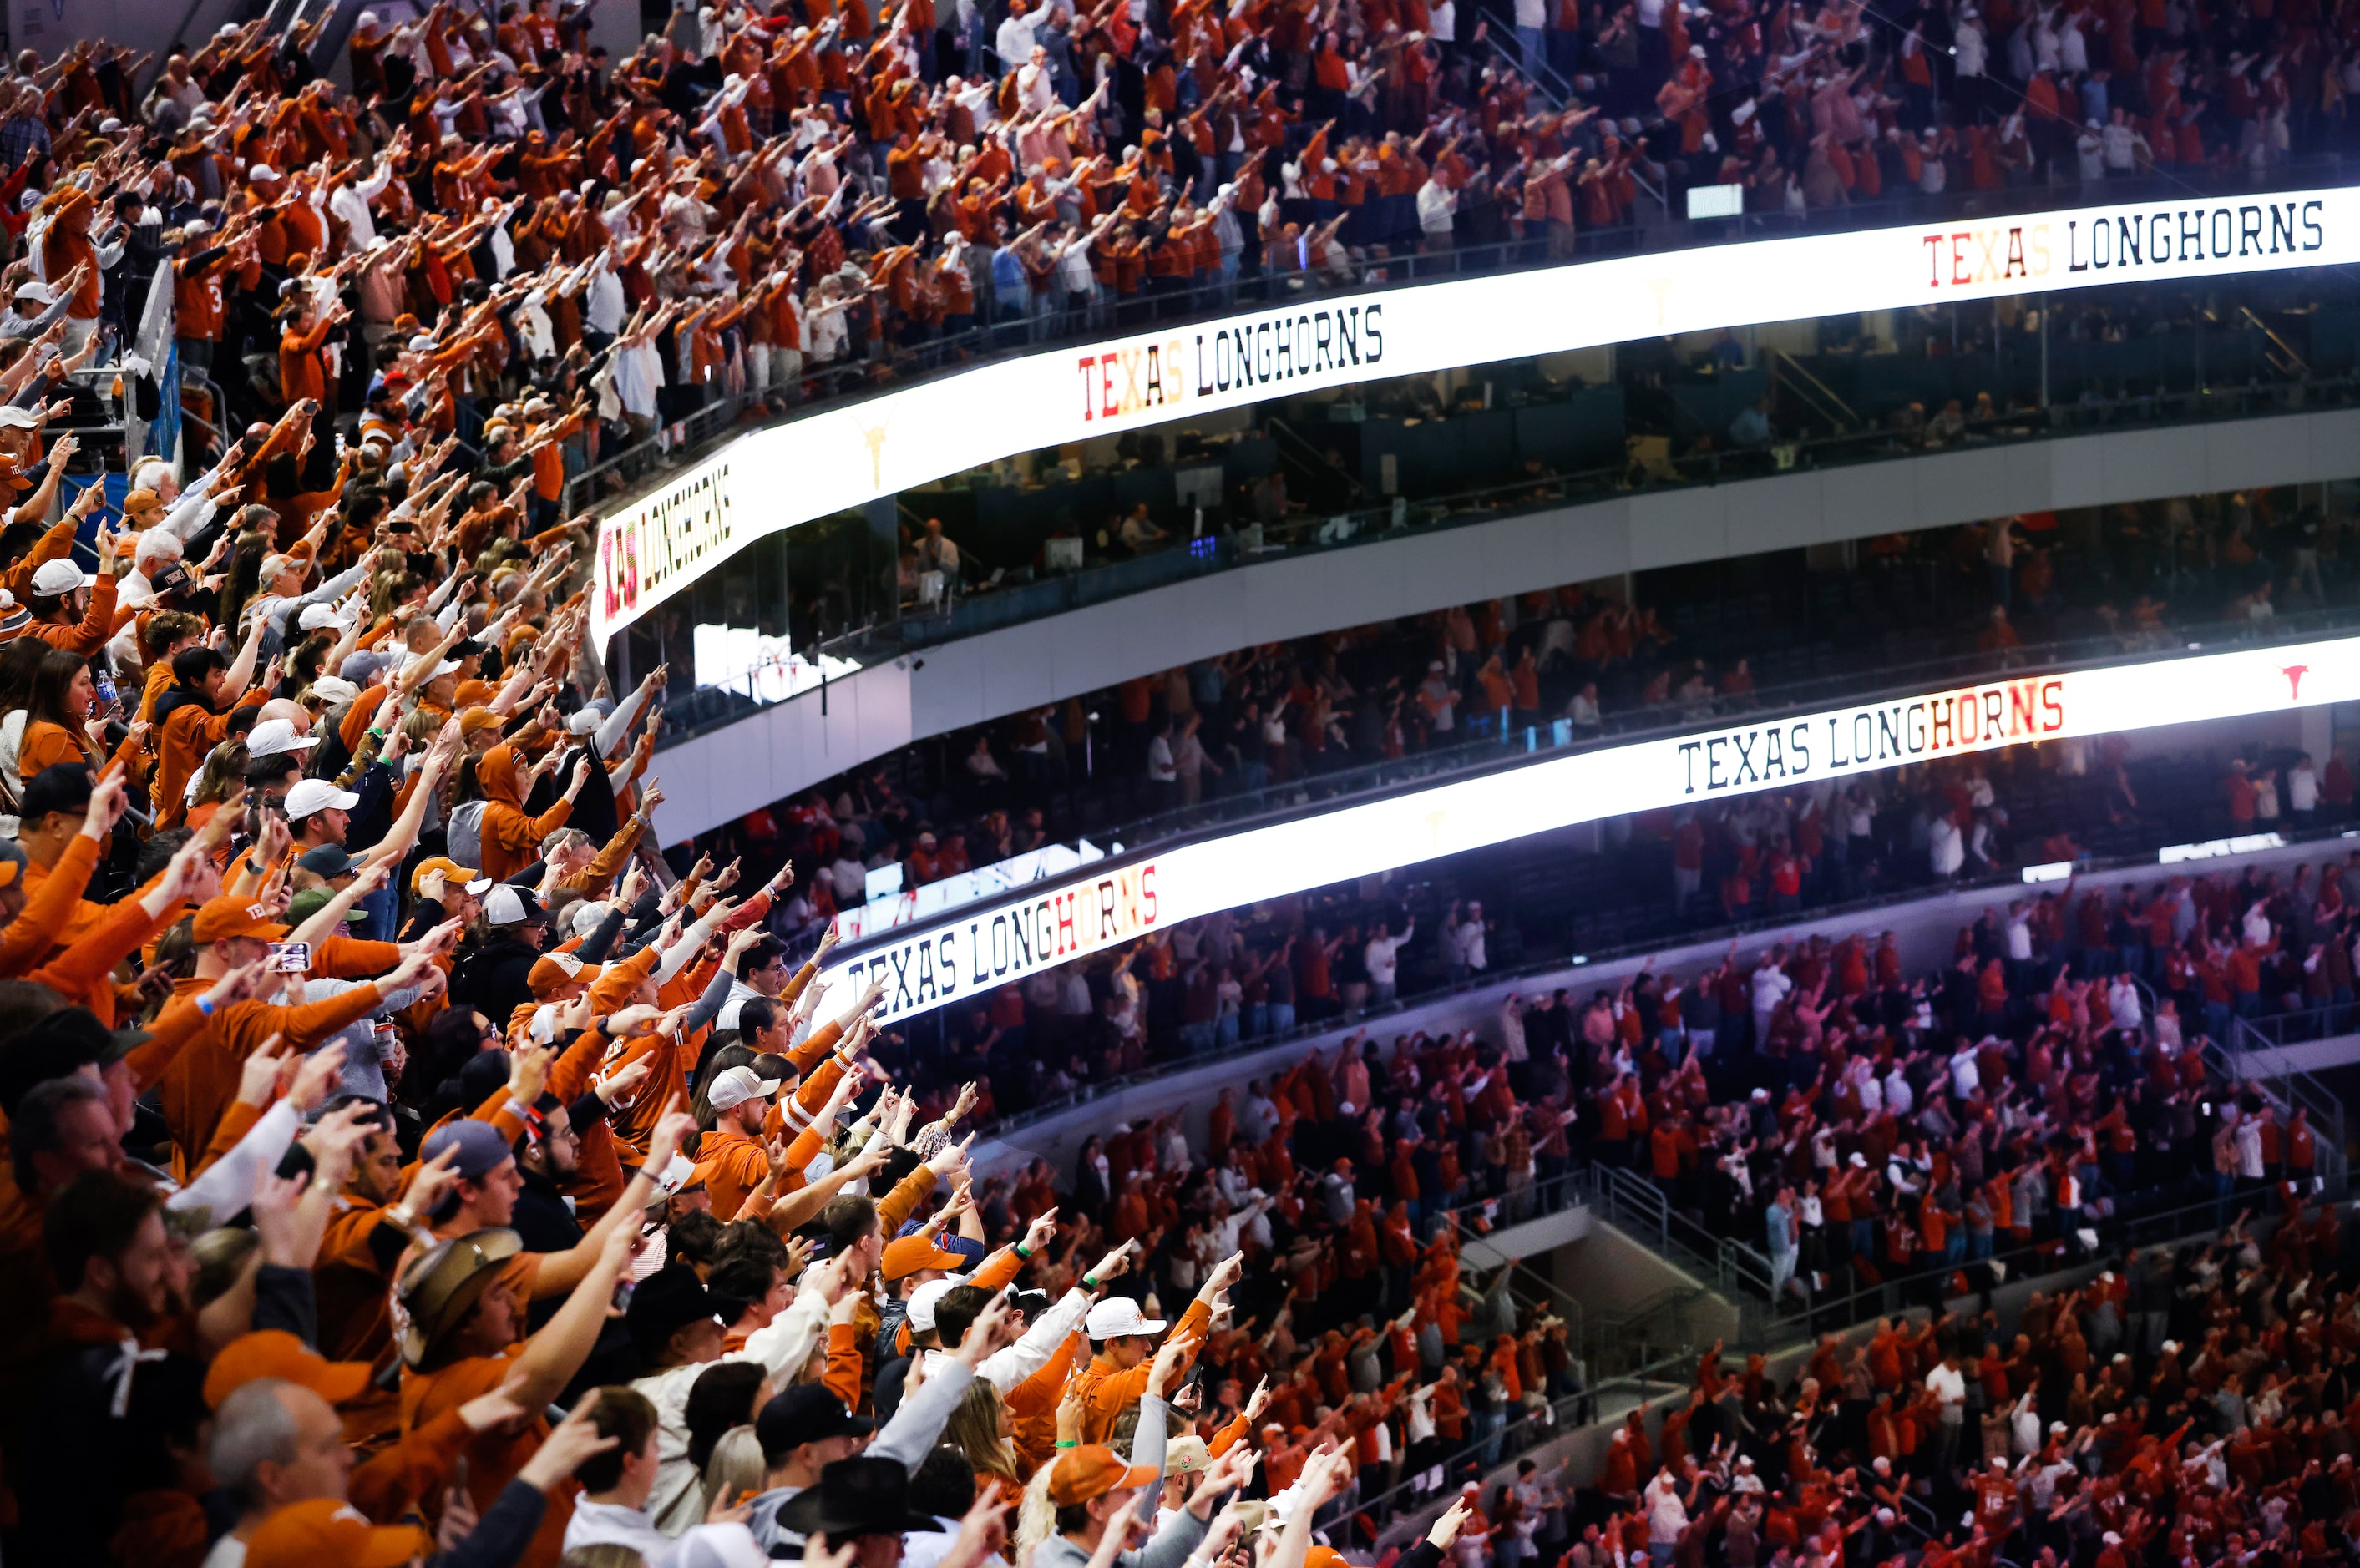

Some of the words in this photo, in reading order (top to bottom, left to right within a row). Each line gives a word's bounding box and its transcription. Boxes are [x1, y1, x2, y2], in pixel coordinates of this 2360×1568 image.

[209, 285, 223, 313] 3
[1923, 224, 2050, 286] TEXAS
[2069, 201, 2322, 271] LONGHORNS
[1079, 340, 1183, 421] TEXAS
[1198, 305, 1382, 397] LONGHORNS
[641, 463, 731, 592] LONGHORNS
[1679, 723, 1809, 794] TEXAS
[1829, 681, 2064, 768] LONGHORNS
[848, 932, 956, 1019] TEXAS
[971, 866, 1157, 984] LONGHORNS
